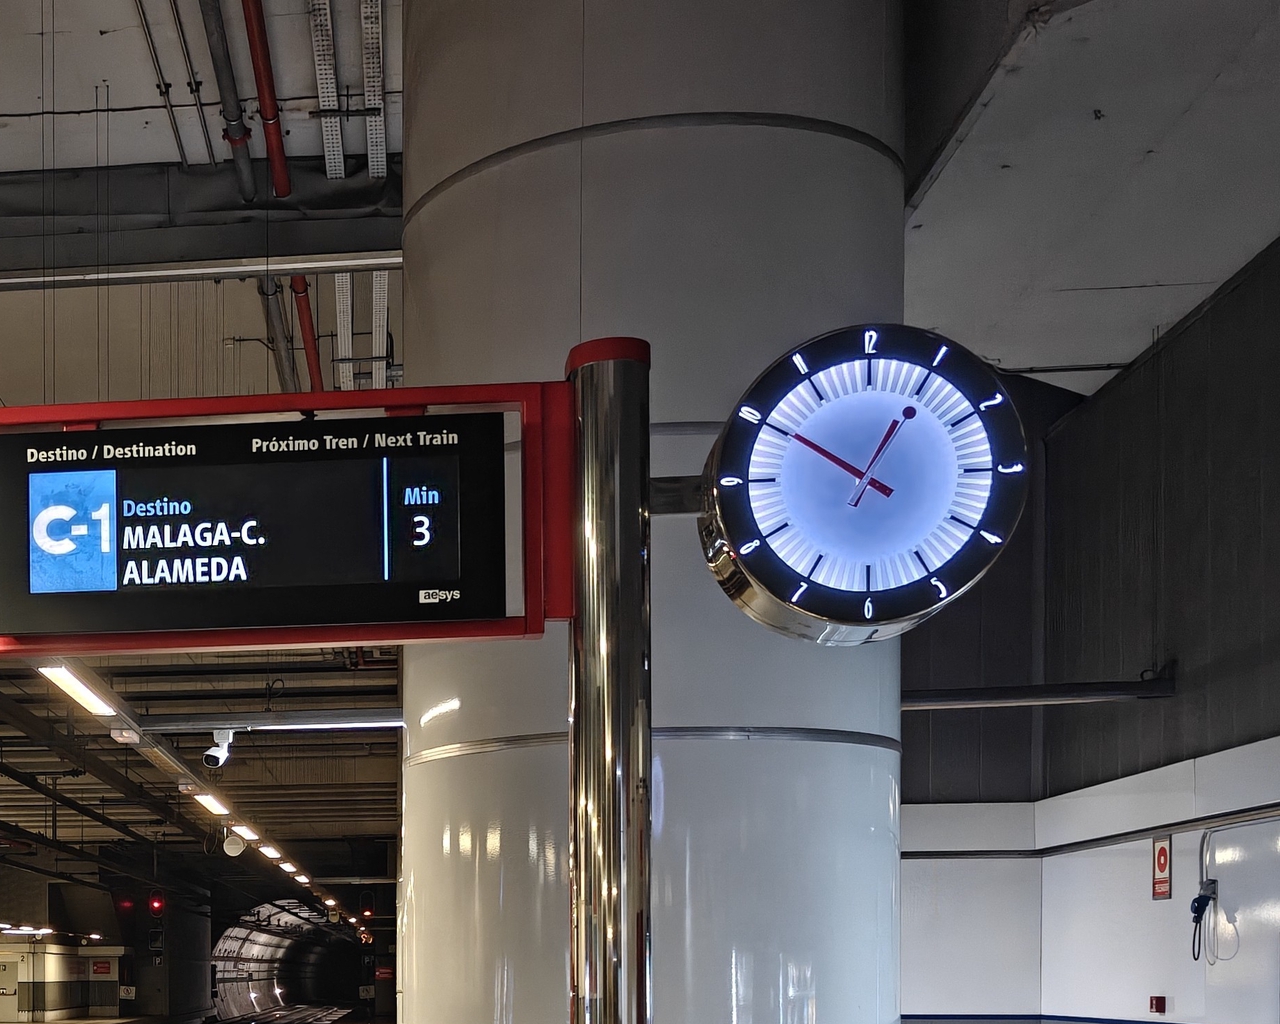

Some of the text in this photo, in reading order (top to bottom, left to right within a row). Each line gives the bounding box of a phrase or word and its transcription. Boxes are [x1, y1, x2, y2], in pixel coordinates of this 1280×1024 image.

[864, 330, 878, 354] 12
[792, 352, 808, 375] 11
[932, 345, 948, 367] 1
[979, 393, 1003, 411] 2
[738, 406, 761, 424] 10
[26, 440, 196, 463] Destino / Destination
[252, 430, 459, 454] Próximo Tren / Next Train
[997, 463, 1023, 473] 3
[720, 477, 743, 486] 9
[122, 496, 192, 518] Destino
[403, 486, 439, 506] Min
[31, 503, 112, 554] C-1
[122, 520, 266, 550] MALAGA-C.
[412, 515, 432, 546] 3
[979, 530, 1003, 545] 4
[739, 540, 760, 555] 8
[122, 556, 248, 585] ALAMEDA
[423, 590, 461, 603] aesys
[791, 582, 808, 603] 7
[931, 577, 948, 599] 5
[864, 597, 873, 619] 6
